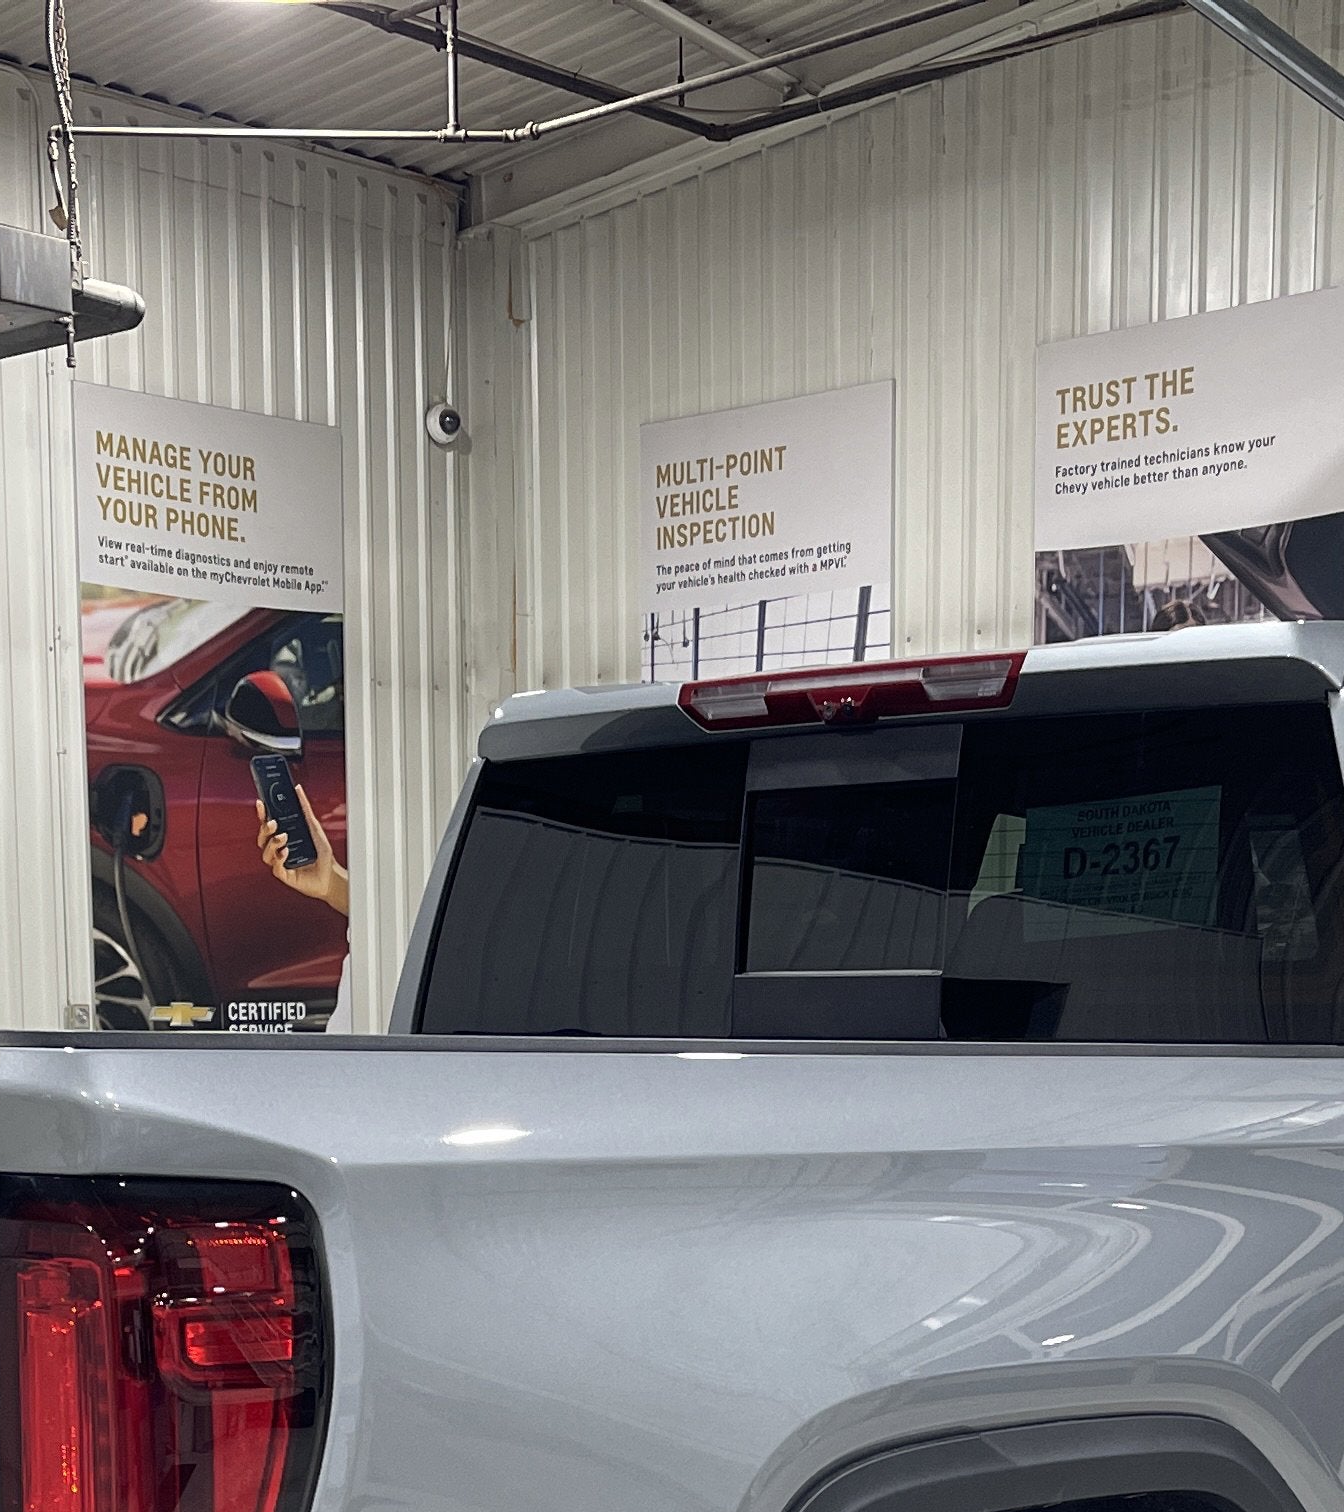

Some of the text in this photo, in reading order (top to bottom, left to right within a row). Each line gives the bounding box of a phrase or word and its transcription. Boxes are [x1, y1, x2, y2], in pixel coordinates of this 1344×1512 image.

[1056, 365, 1194, 415] TRUST THE
[1056, 406, 1178, 449] EXPERTS.
[95, 430, 256, 482] MANAGE YOUR
[656, 445, 787, 489] MULTI-POINT
[1055, 434, 1276, 479] Factory trained technicians know your
[95, 462, 258, 514] VEHICLE FROM
[1055, 458, 1248, 496] Chevy vehicle better than anyone.
[96, 495, 246, 543] YOUR PHONE.
[656, 484, 739, 519] VEHICLE
[656, 511, 775, 550] INSPECTION
[97, 535, 314, 577] View real-time diagnostics and enjoy remote
[130, 557, 174, 576] available
[177, 566, 189, 577] on
[191, 565, 208, 580] the
[210, 569, 271, 589] myChevrolet
[272, 577, 302, 591] Mobile
[656, 540, 851, 577] The peace of mind that comes from getting
[656, 580, 675, 594] your
[678, 573, 716, 590] vehicle's
[718, 569, 746, 585] health
[748, 564, 786, 581] checked
[788, 561, 810, 576] with
[811, 563, 818, 573] a
[1071, 816, 1175, 839] VEHICLE DEALER
[1076, 799, 1172, 823] SOUTH DAKOTA
[1062, 835, 1182, 880] D-2367
[227, 1002, 307, 1021] CERTIFIED
